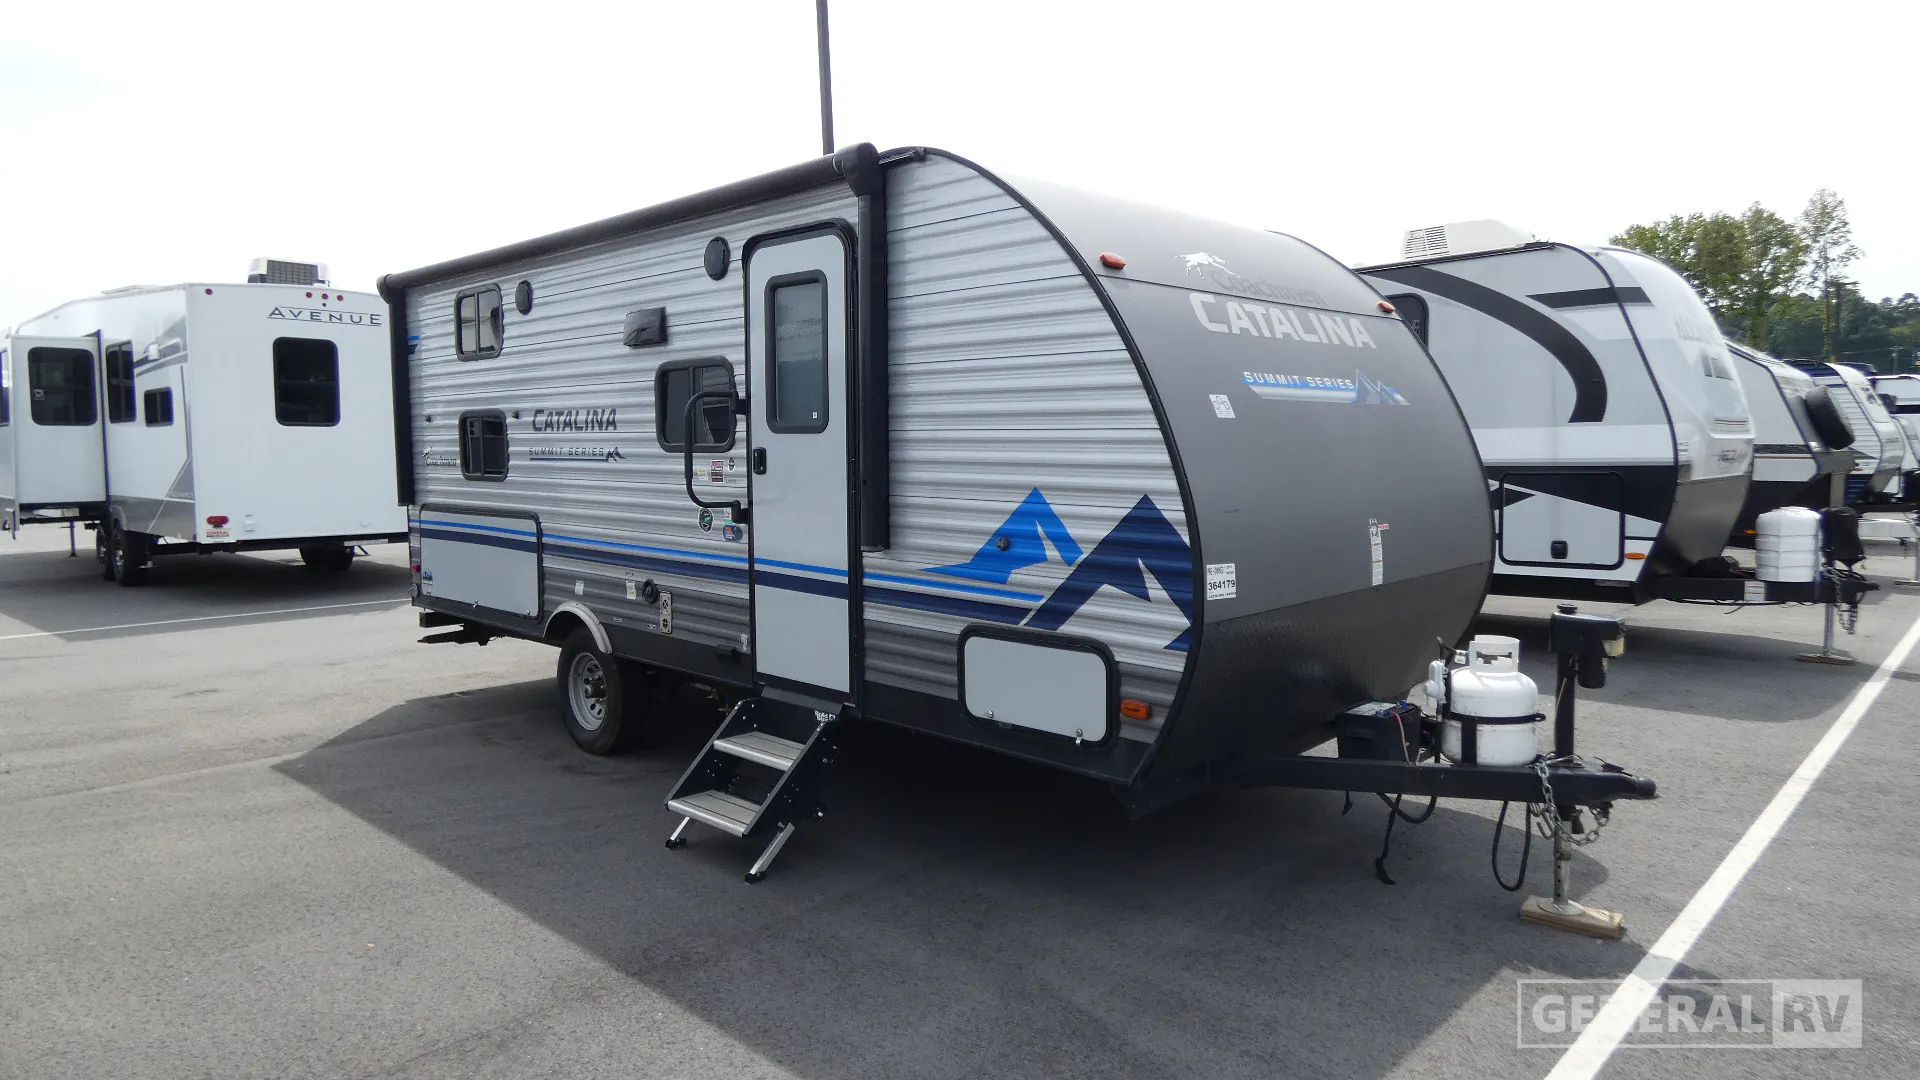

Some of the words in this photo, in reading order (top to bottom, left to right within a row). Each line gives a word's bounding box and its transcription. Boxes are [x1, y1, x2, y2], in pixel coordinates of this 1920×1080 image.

[269, 307, 382, 325] AVENUE
[1189, 292, 1377, 349] CATALINA
[1244, 372, 1300, 385] SUMMIT
[1306, 376, 1354, 389] SERIES
[532, 408, 617, 431] CATALINA
[528, 447, 563, 456] SUMMIT
[568, 447, 604, 456] SERIES
[1208, 579, 1236, 591] 364179
